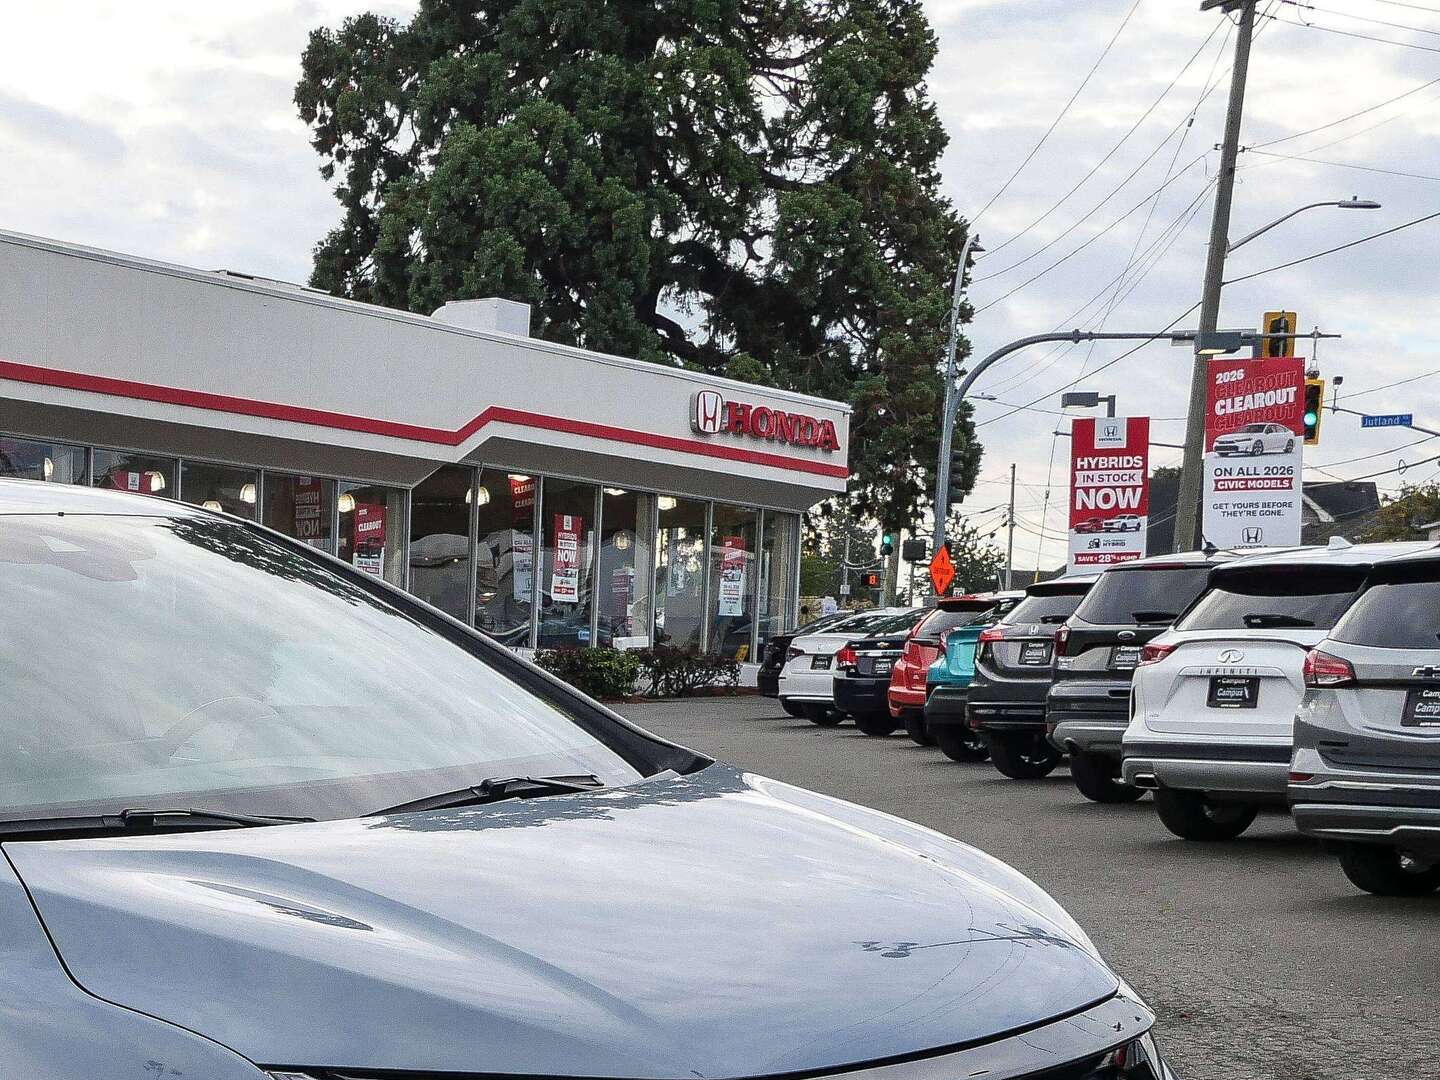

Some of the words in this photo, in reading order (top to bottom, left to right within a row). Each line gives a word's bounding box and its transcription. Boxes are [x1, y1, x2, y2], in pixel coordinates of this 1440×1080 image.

[1215, 388, 1297, 416] CLEAROUT
[726, 401, 840, 450] HONDA
[1364, 416, 1400, 427] Jutland
[1076, 456, 1142, 469] HYBRIDS
[1214, 467, 1232, 477] ON
[1237, 466, 1260, 476] ALL
[1264, 466, 1293, 476] 2026
[1082, 474, 1094, 483] IN
[1098, 474, 1136, 482] STOCK
[1218, 480, 1246, 489] CIVIC
[1247, 479, 1289, 488] MODELS
[1076, 488, 1142, 510] NOW
[558, 550, 576, 562] NOW
[1217, 688, 1244, 698] Campus
[1415, 702, 1440, 714] Camp
